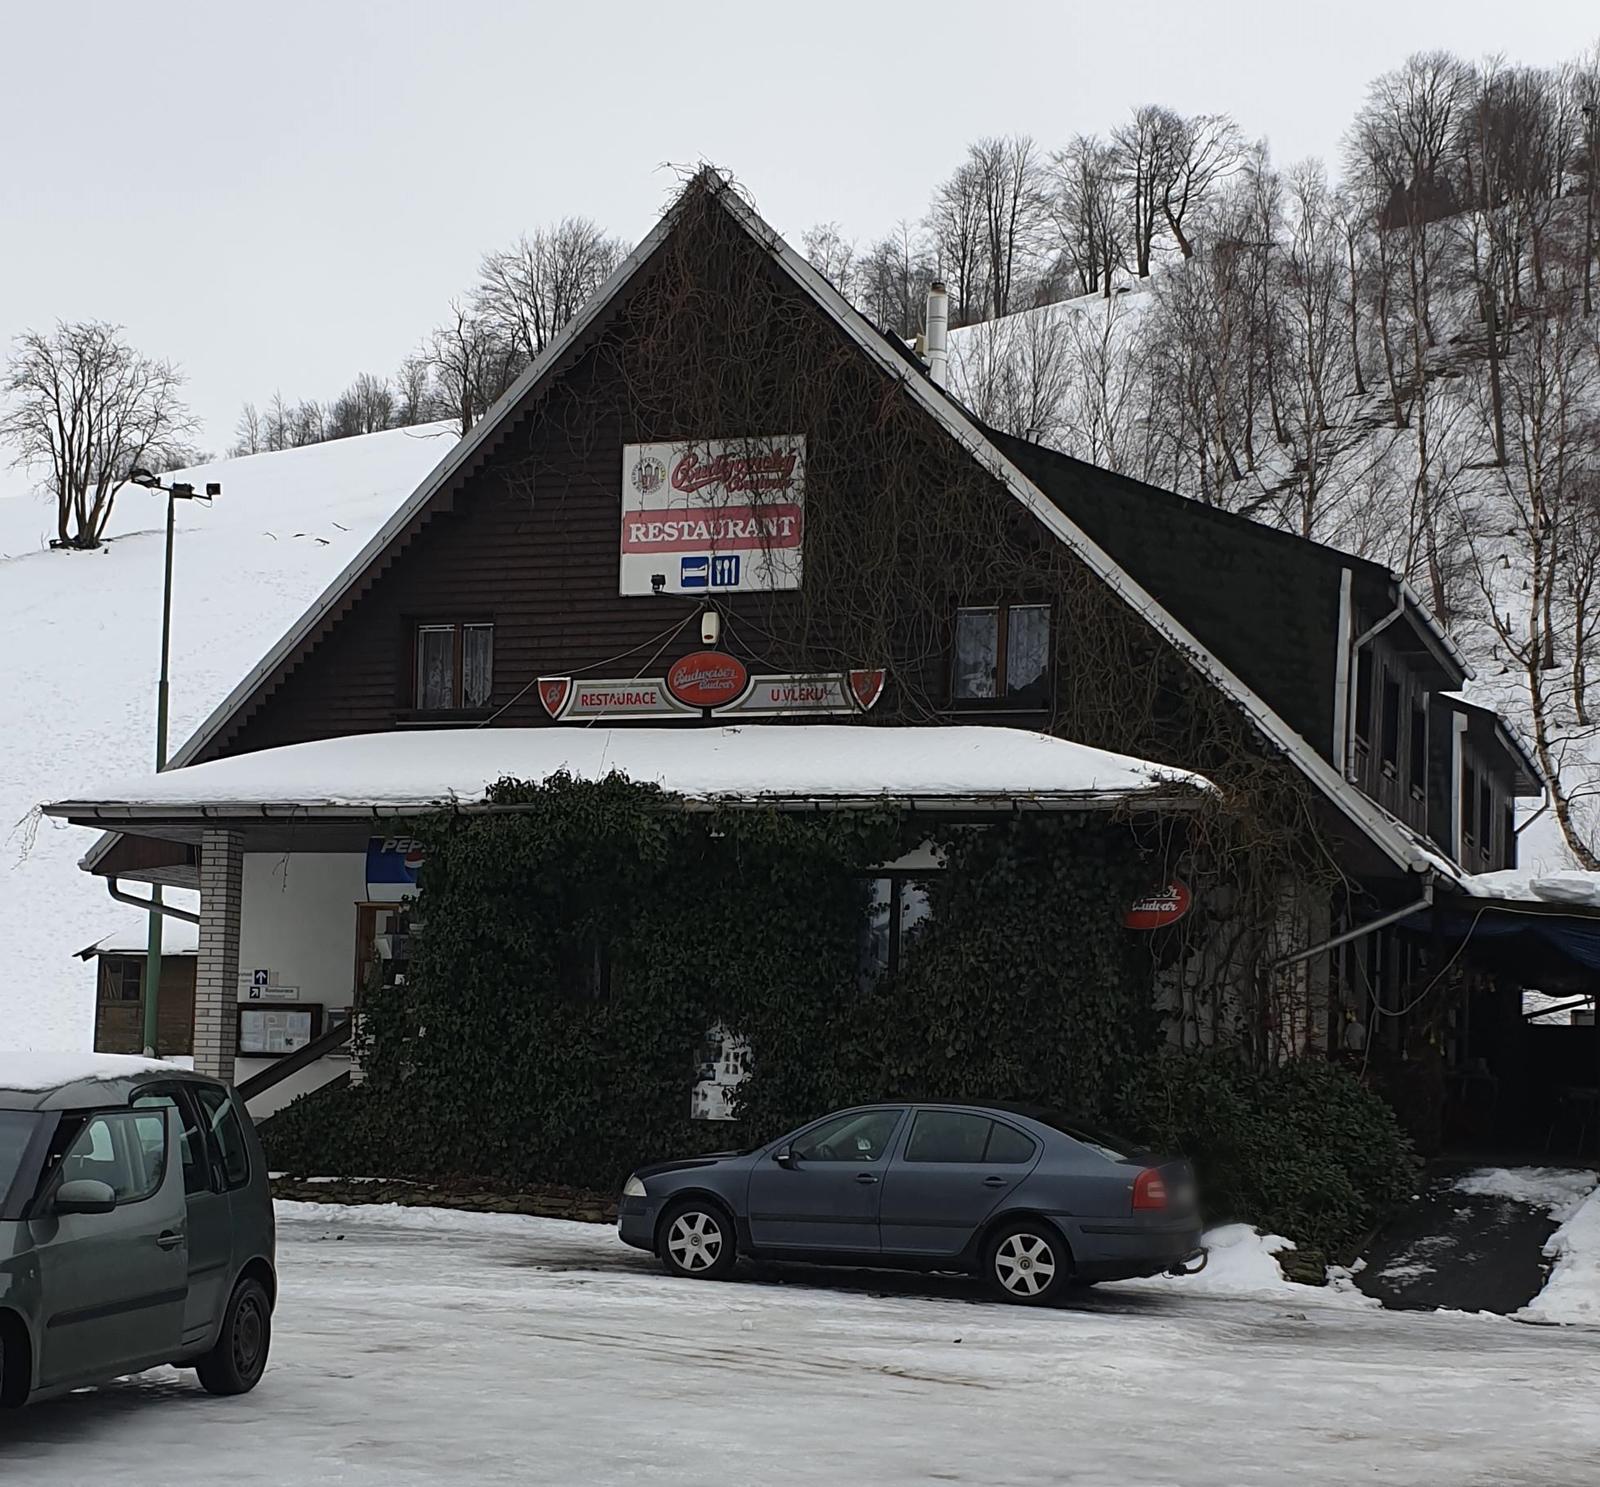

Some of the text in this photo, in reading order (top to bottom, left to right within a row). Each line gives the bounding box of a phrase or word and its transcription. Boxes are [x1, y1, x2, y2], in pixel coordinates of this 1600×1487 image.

[628, 516, 796, 543] RESTAURANT
[673, 664, 738, 689] Budweiser
[580, 691, 657, 706] RESTAURACE
[770, 689, 780, 702] U
